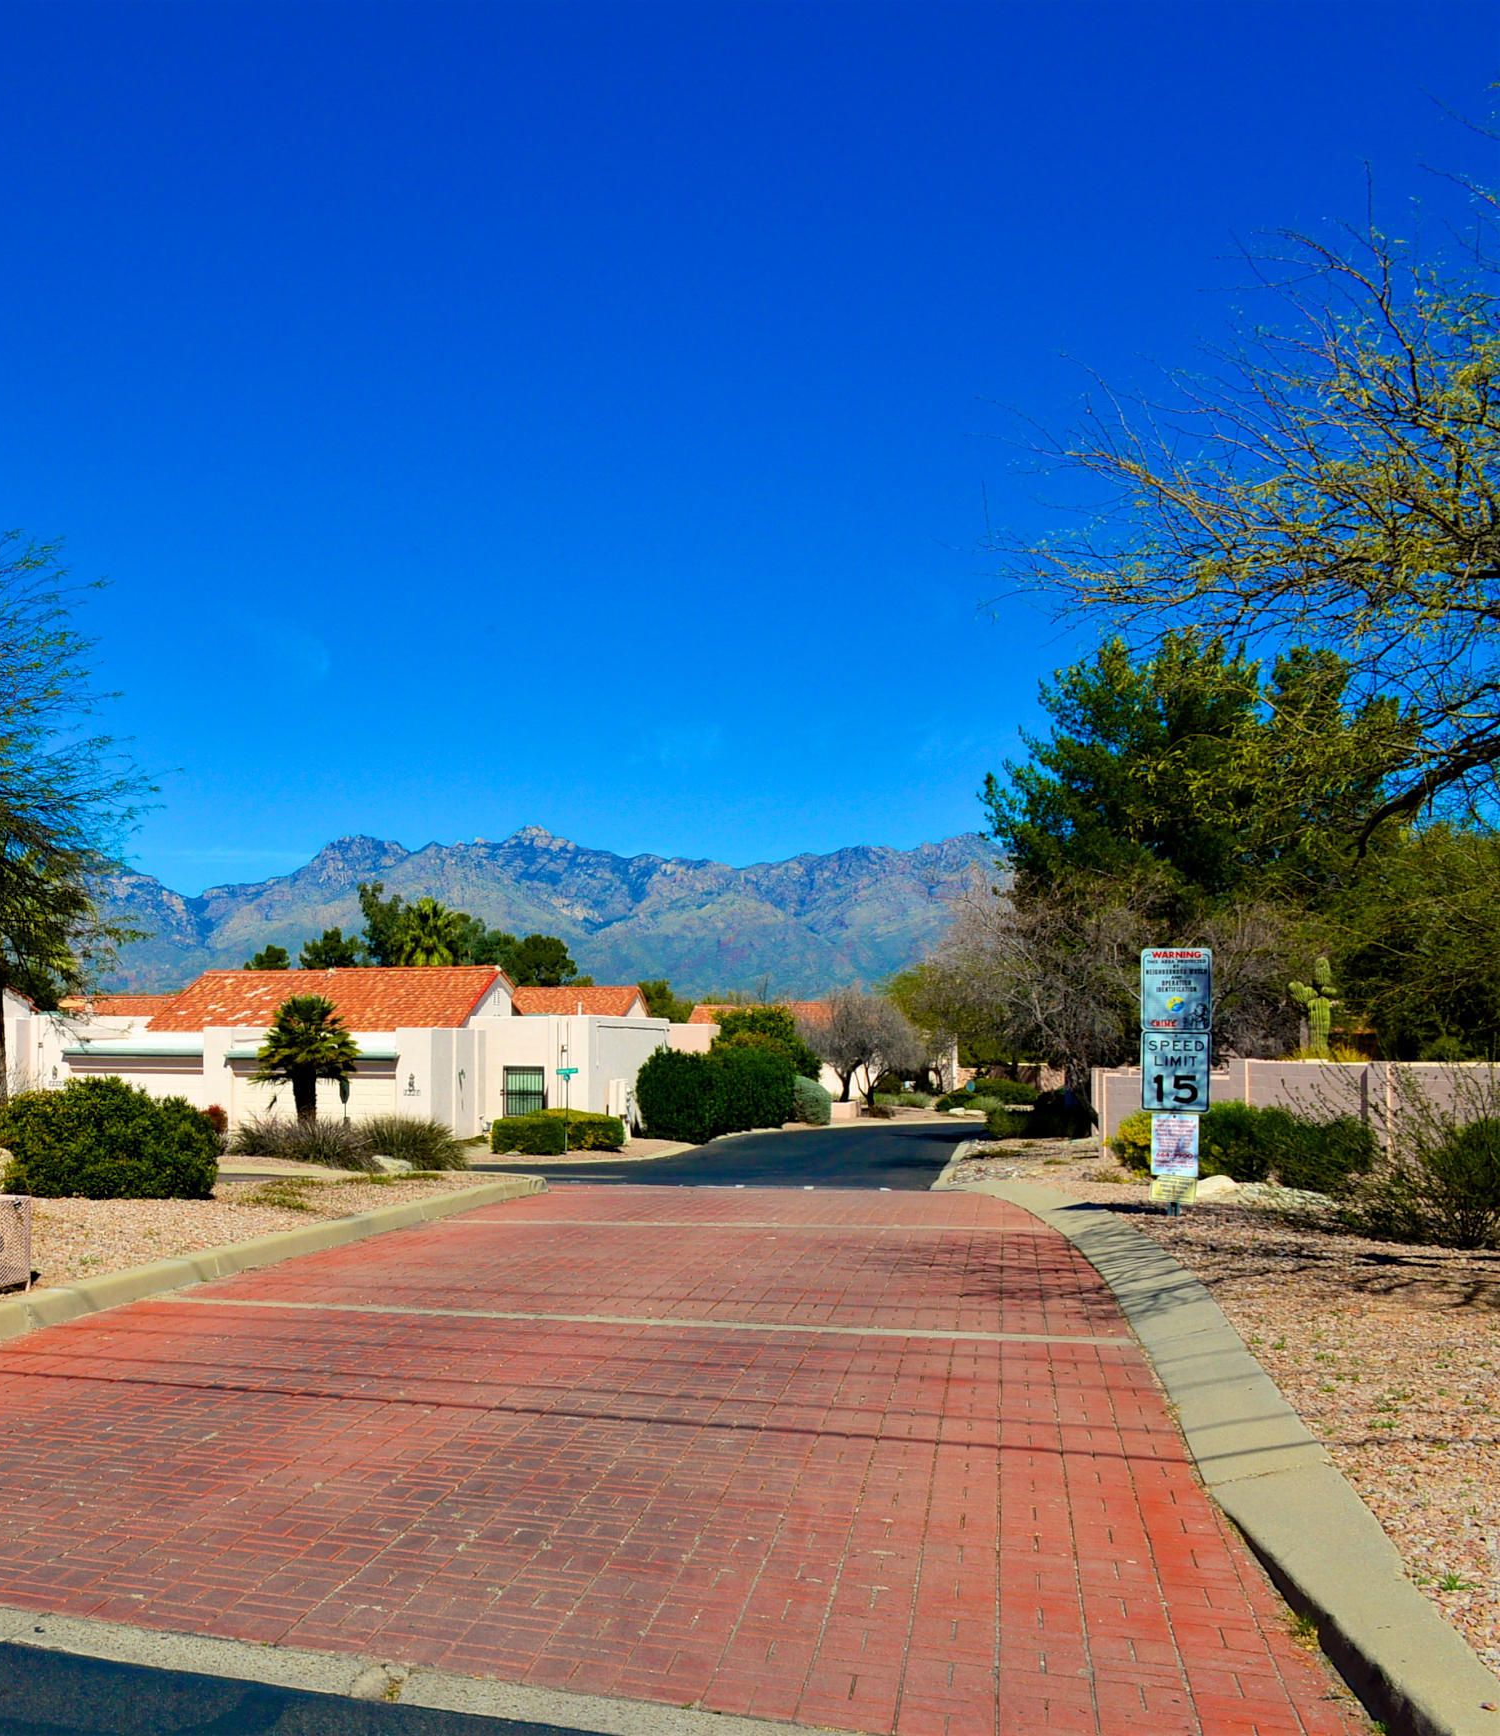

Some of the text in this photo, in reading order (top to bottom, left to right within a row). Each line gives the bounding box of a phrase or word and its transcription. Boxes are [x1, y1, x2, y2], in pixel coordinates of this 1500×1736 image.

[1148, 1040, 1205, 1052] SPEED
[1154, 1055, 1198, 1067] LIMIT
[1153, 1074, 1199, 1104] 15
